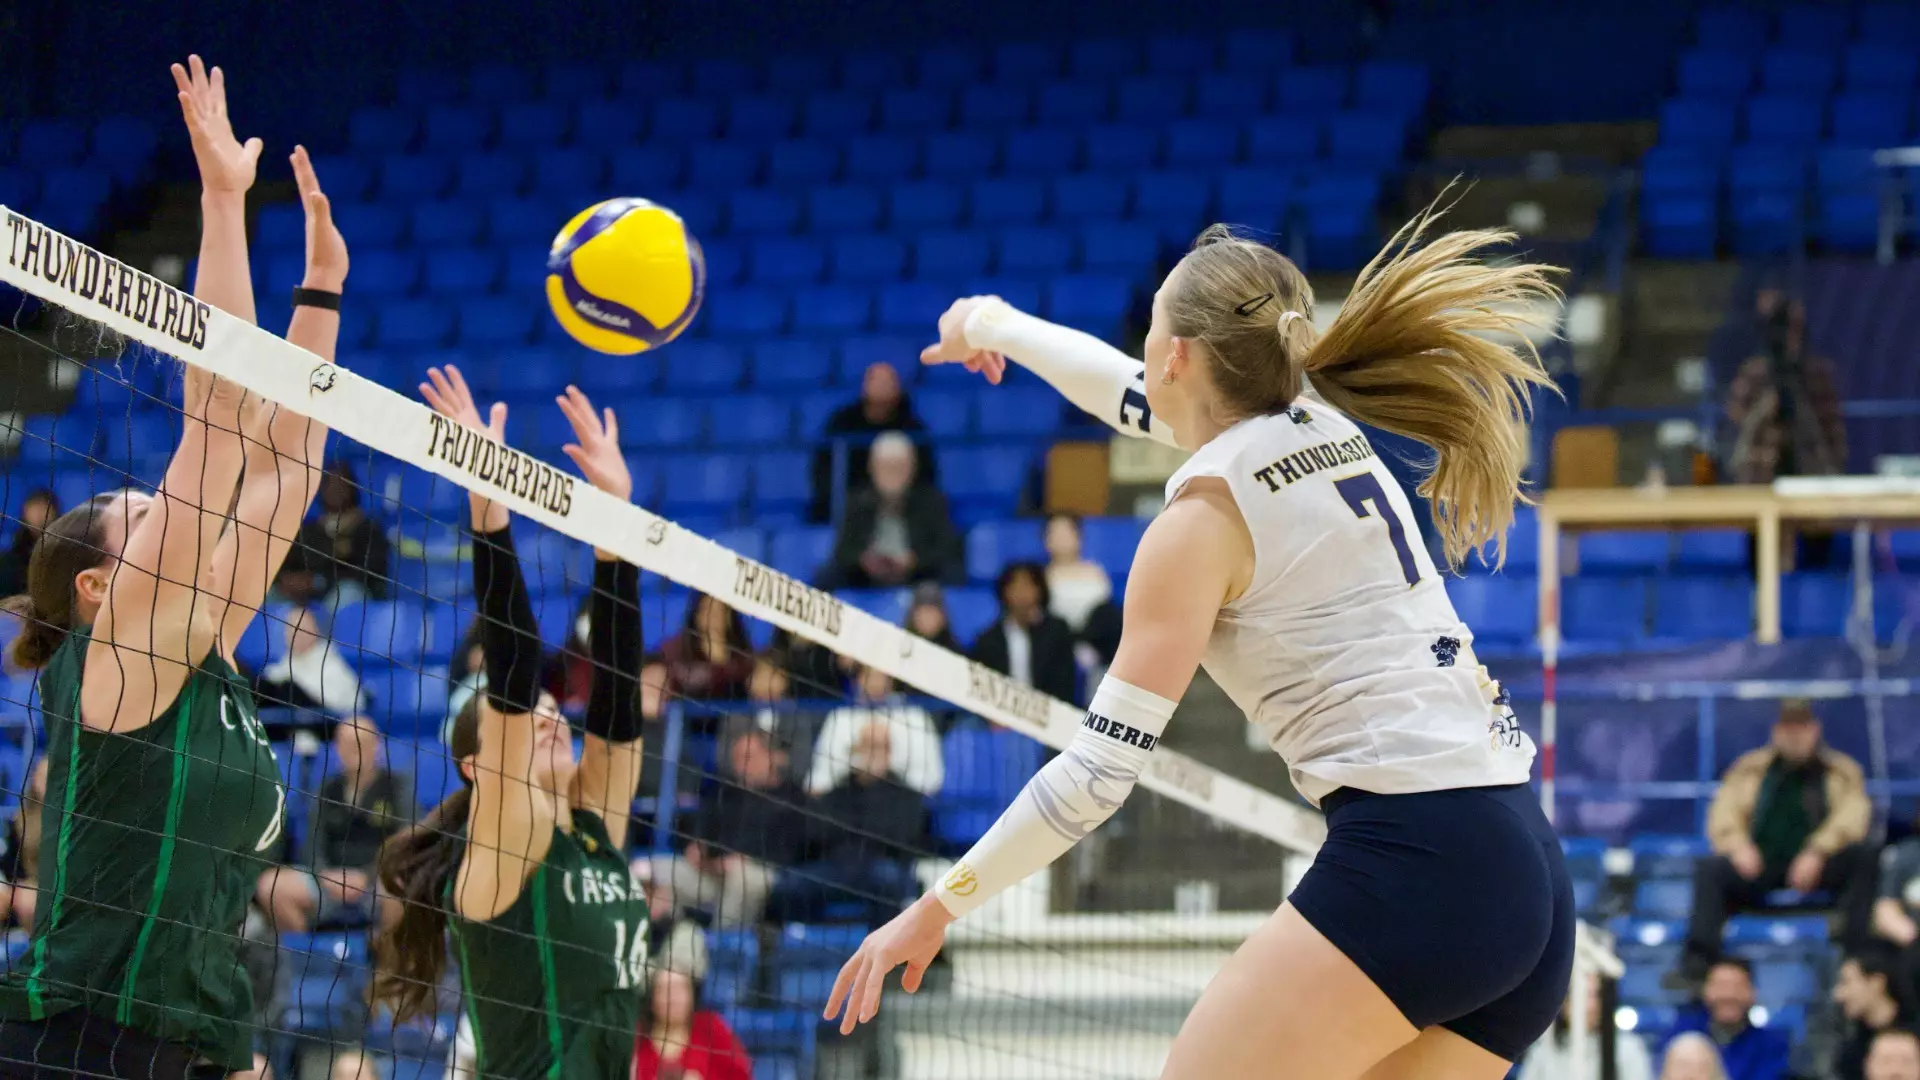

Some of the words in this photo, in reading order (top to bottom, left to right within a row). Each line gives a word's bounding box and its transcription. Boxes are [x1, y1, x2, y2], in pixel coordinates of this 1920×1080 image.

[7, 212, 211, 351] THUNDERBIRDS
[428, 411, 575, 518] THUNDERBIRDS
[1332, 468, 1426, 591] 7
[613, 917, 649, 991] 16
